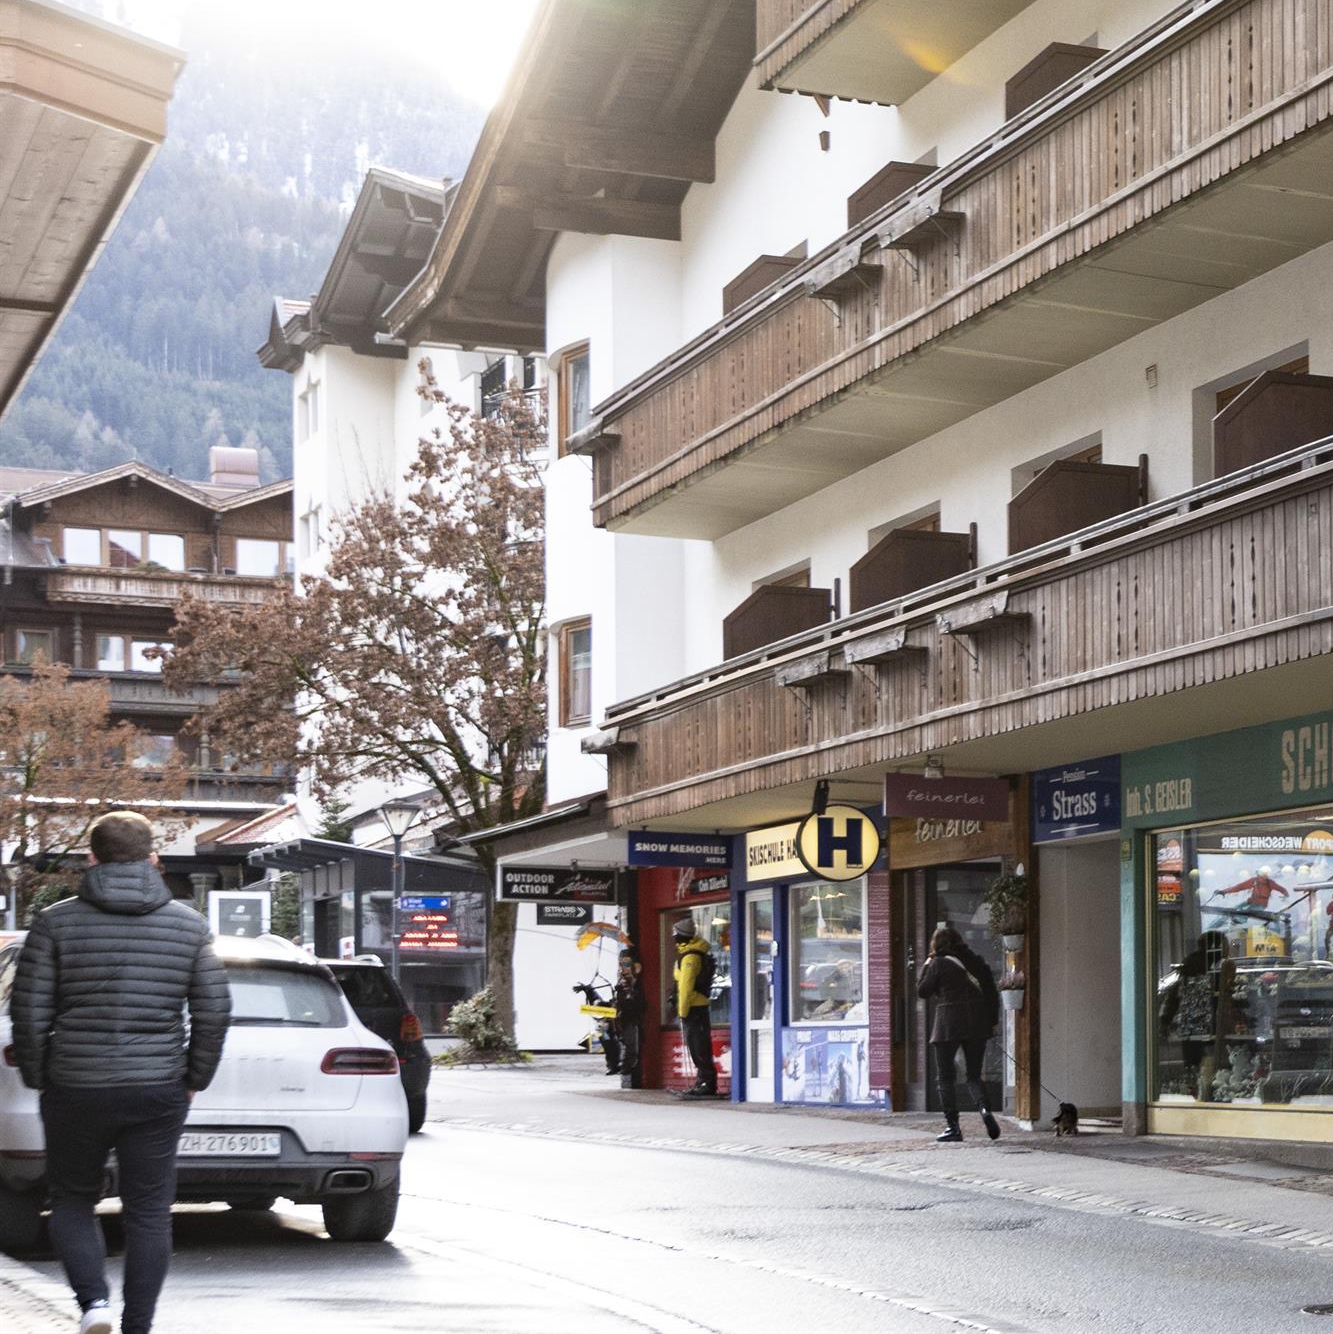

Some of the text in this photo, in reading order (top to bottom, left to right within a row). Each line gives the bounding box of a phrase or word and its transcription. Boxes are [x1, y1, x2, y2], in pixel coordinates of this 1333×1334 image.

[906, 789, 985, 805] feinerlei
[1052, 789, 1097, 821] Strass
[1126, 777, 1192, 818] Inh. S. GEISLER
[635, 842, 727, 856] SNOW MEMORIES
[817, 817, 863, 868] H
[704, 856, 727, 864] HERE
[749, 840, 785, 867] SKISCHULE
[505, 873, 555, 884] OUTDOOR
[511, 884, 549, 895] ACTION
